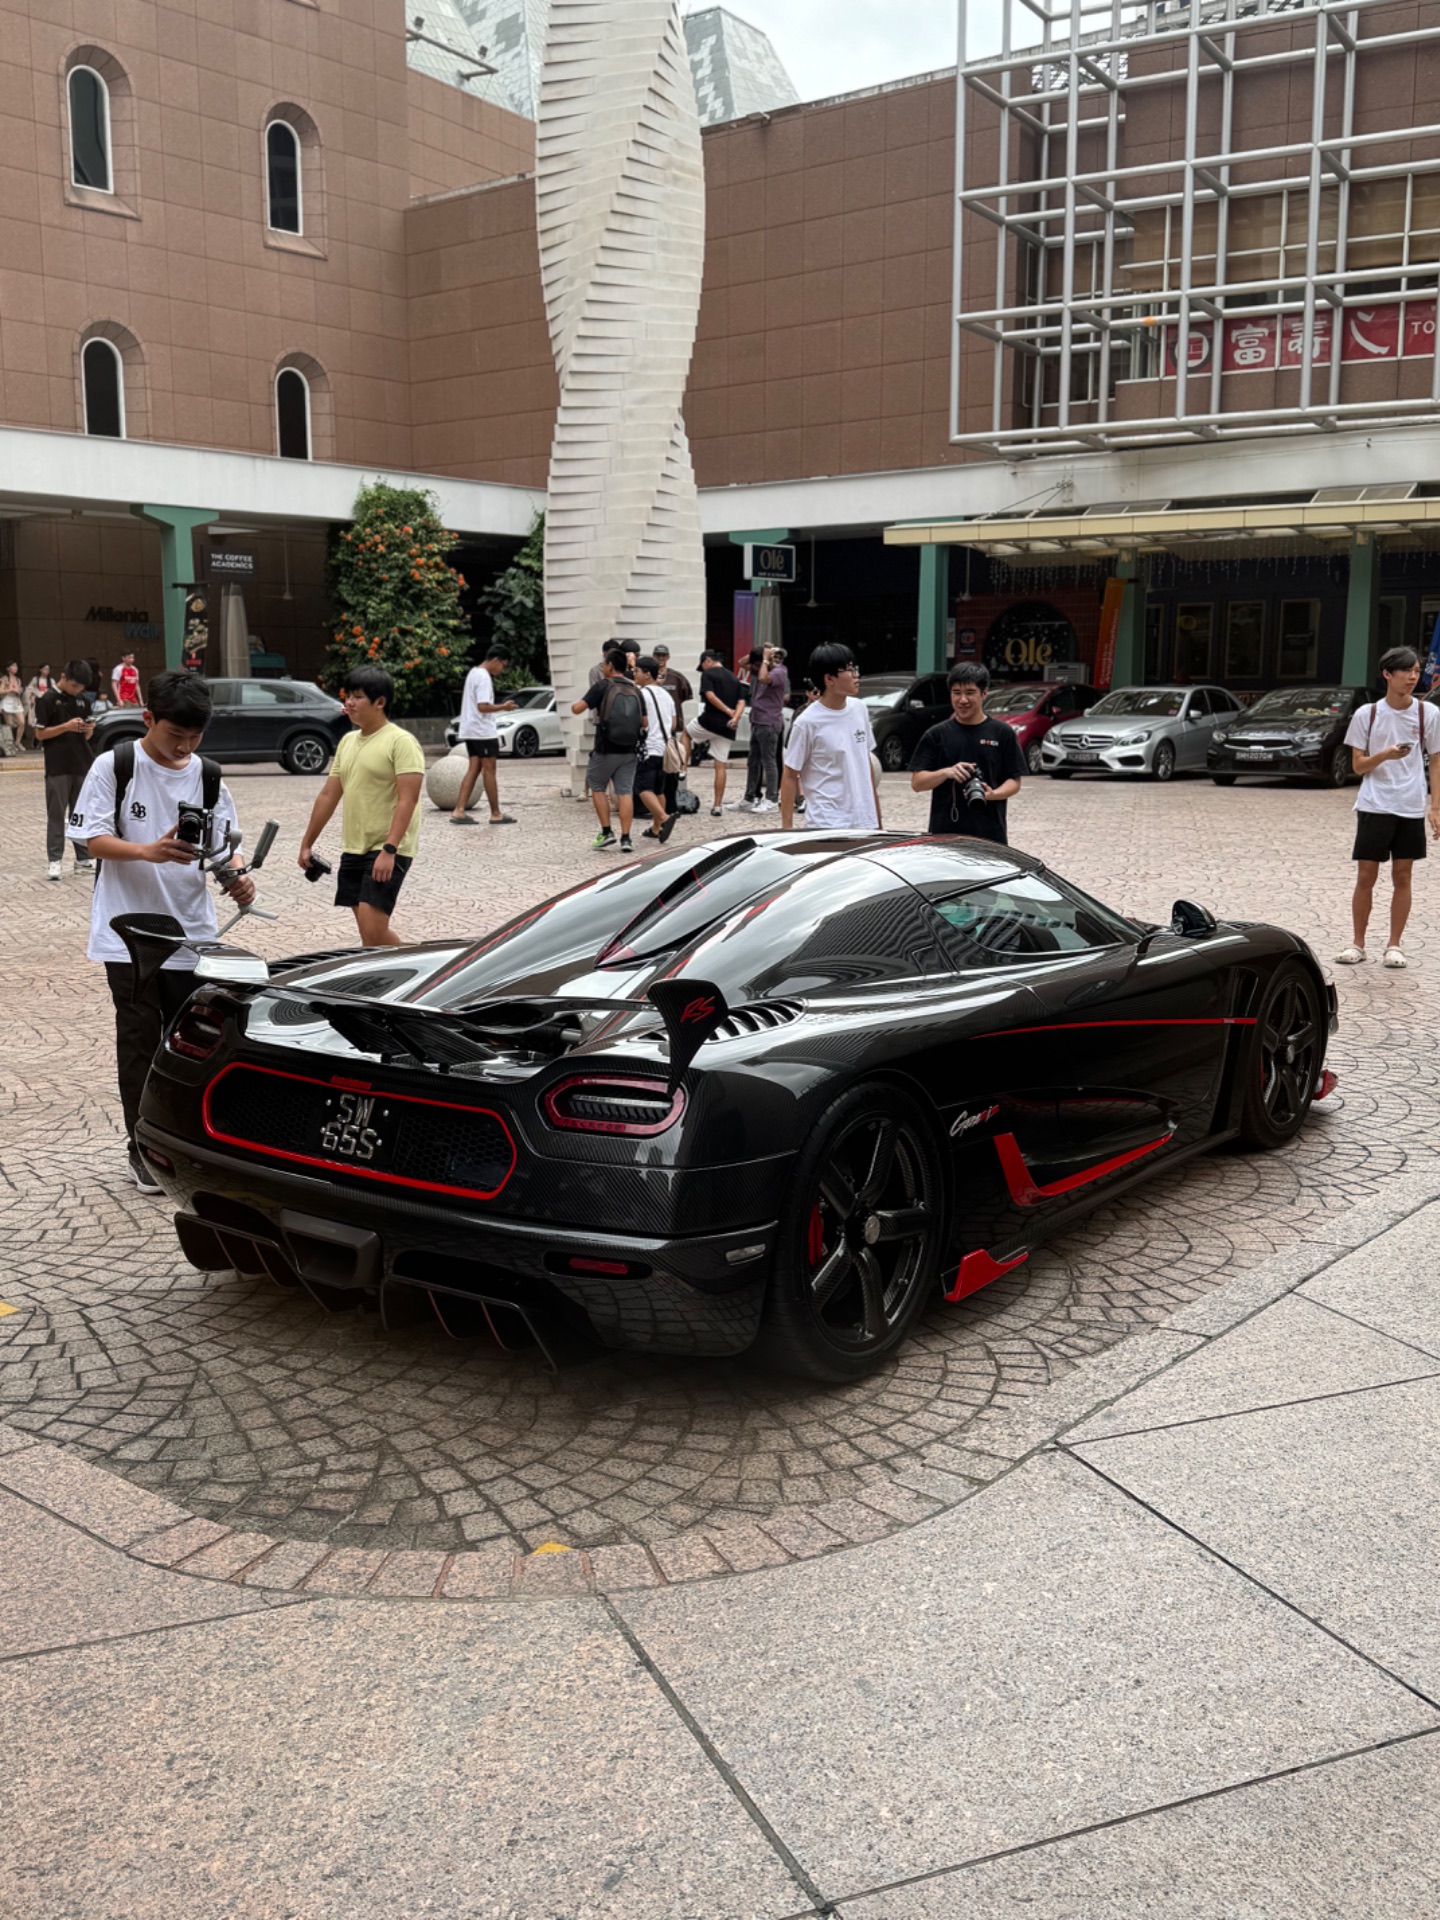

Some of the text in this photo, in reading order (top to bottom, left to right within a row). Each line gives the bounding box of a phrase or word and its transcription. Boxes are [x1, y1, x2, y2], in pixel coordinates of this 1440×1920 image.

[225, 554, 253, 563] COFFEE
[759, 548, 785, 571] Olé
[84, 606, 149, 622] Millenia
[1005, 635, 1052, 666] Olé
[680, 995, 716, 1024] RS
[336, 1093, 376, 1127] SW
